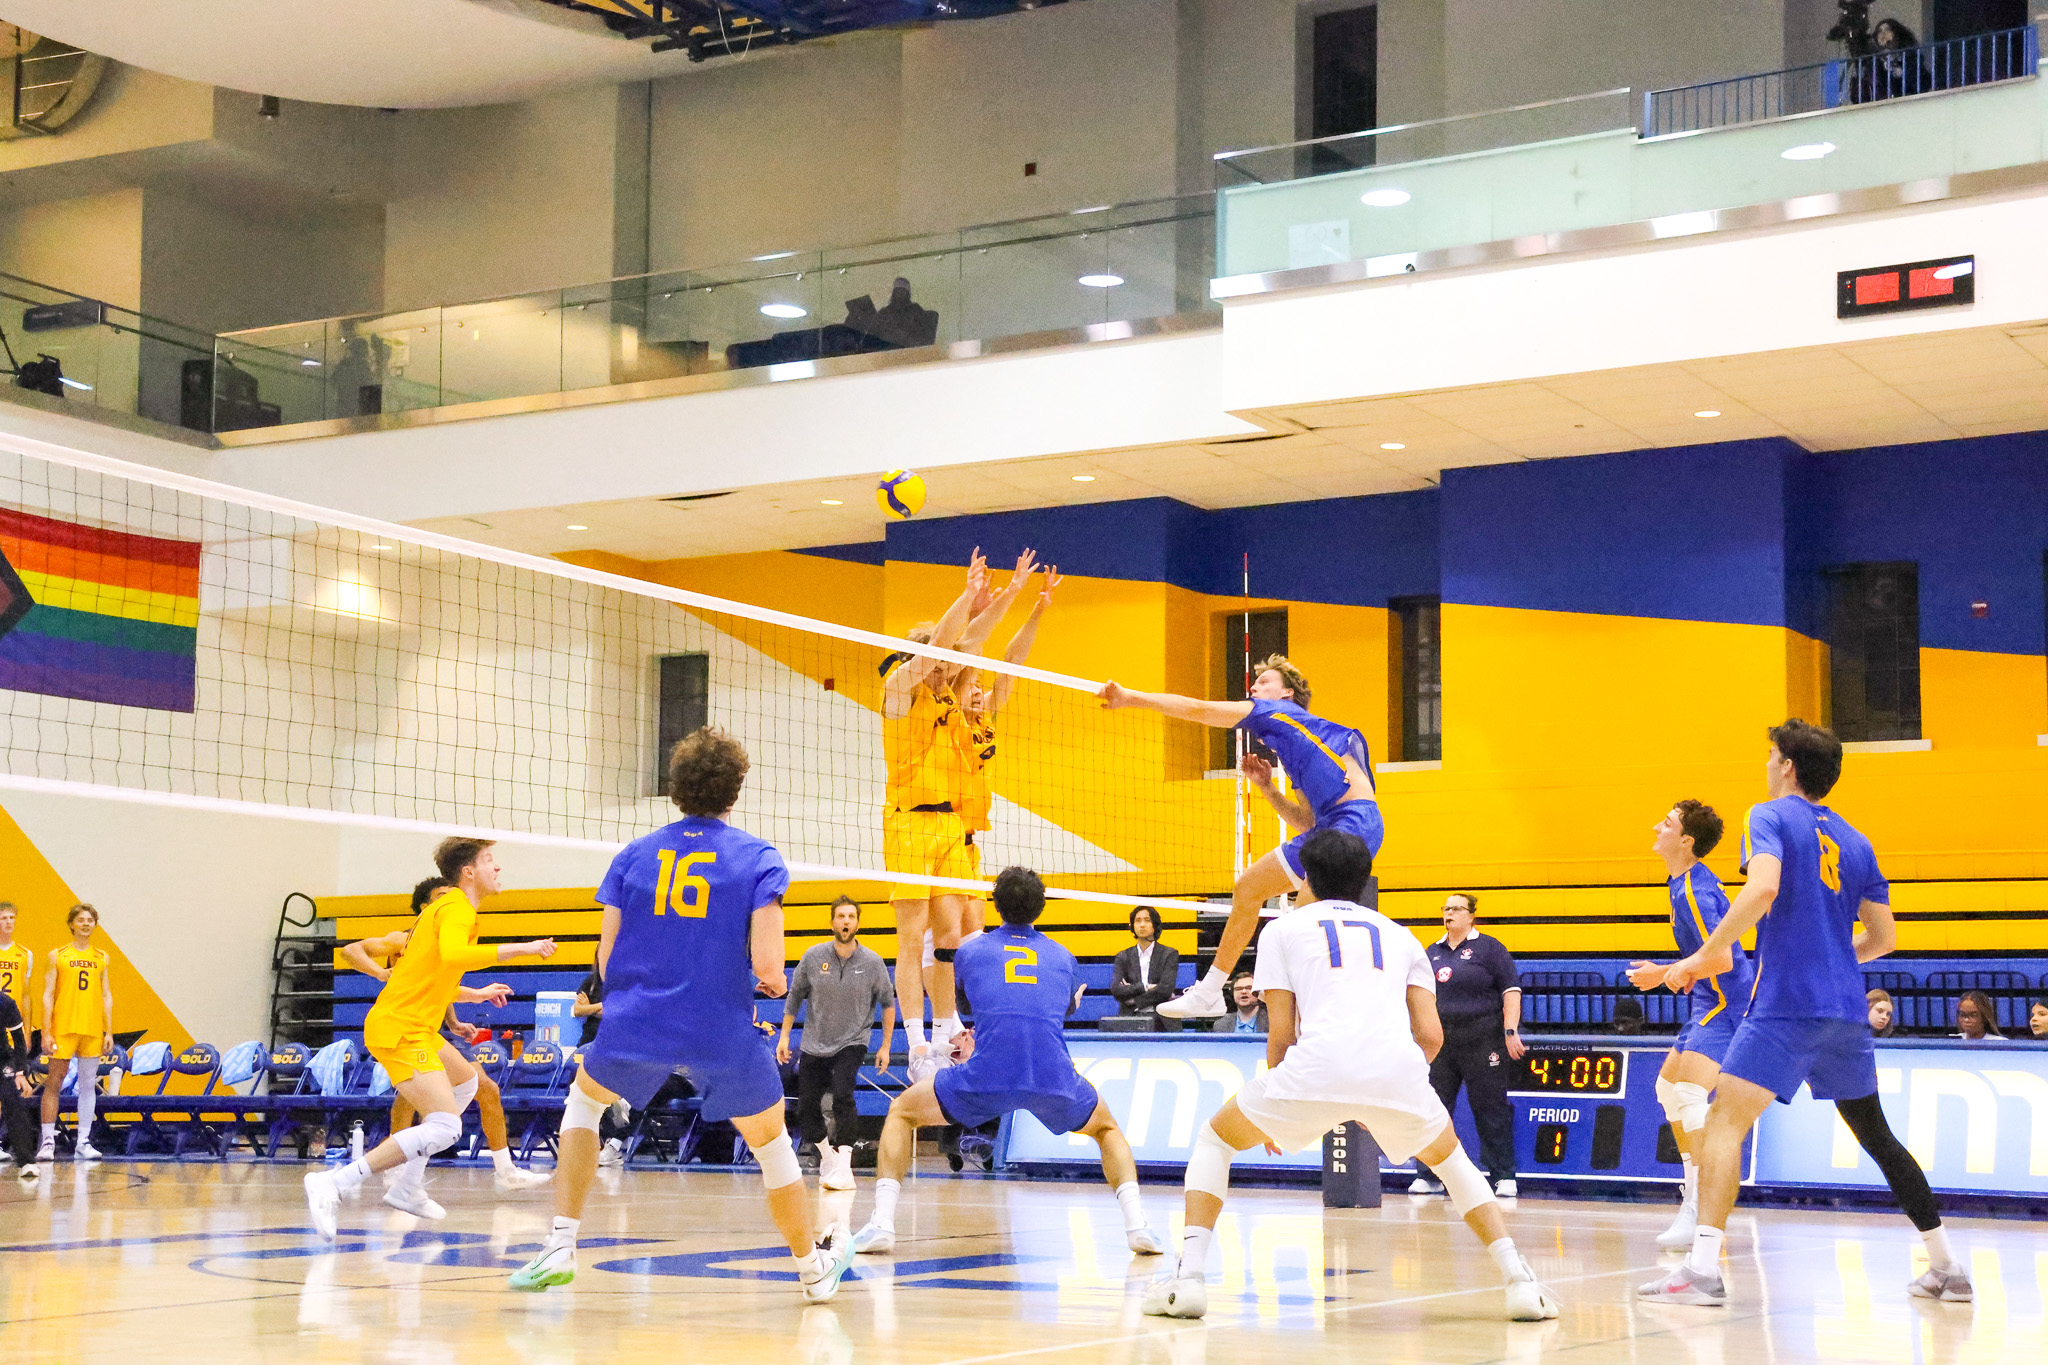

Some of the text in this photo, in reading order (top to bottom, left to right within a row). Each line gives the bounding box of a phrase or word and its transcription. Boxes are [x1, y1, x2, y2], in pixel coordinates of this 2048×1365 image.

[654, 849, 717, 918] 16
[1318, 920, 1384, 971] 17
[1004, 945, 1038, 984] 2
[78, 970, 89, 991] 6
[180, 1054, 211, 1064] BOLD
[271, 1054, 303, 1064] BOLD
[474, 1053, 499, 1064] OLD
[523, 1053, 554, 1064] BOLD
[1530, 1056, 1616, 1089] 4:00
[1528, 1108, 1580, 1123] PERIOD
[1553, 1131, 1562, 1157] 1
